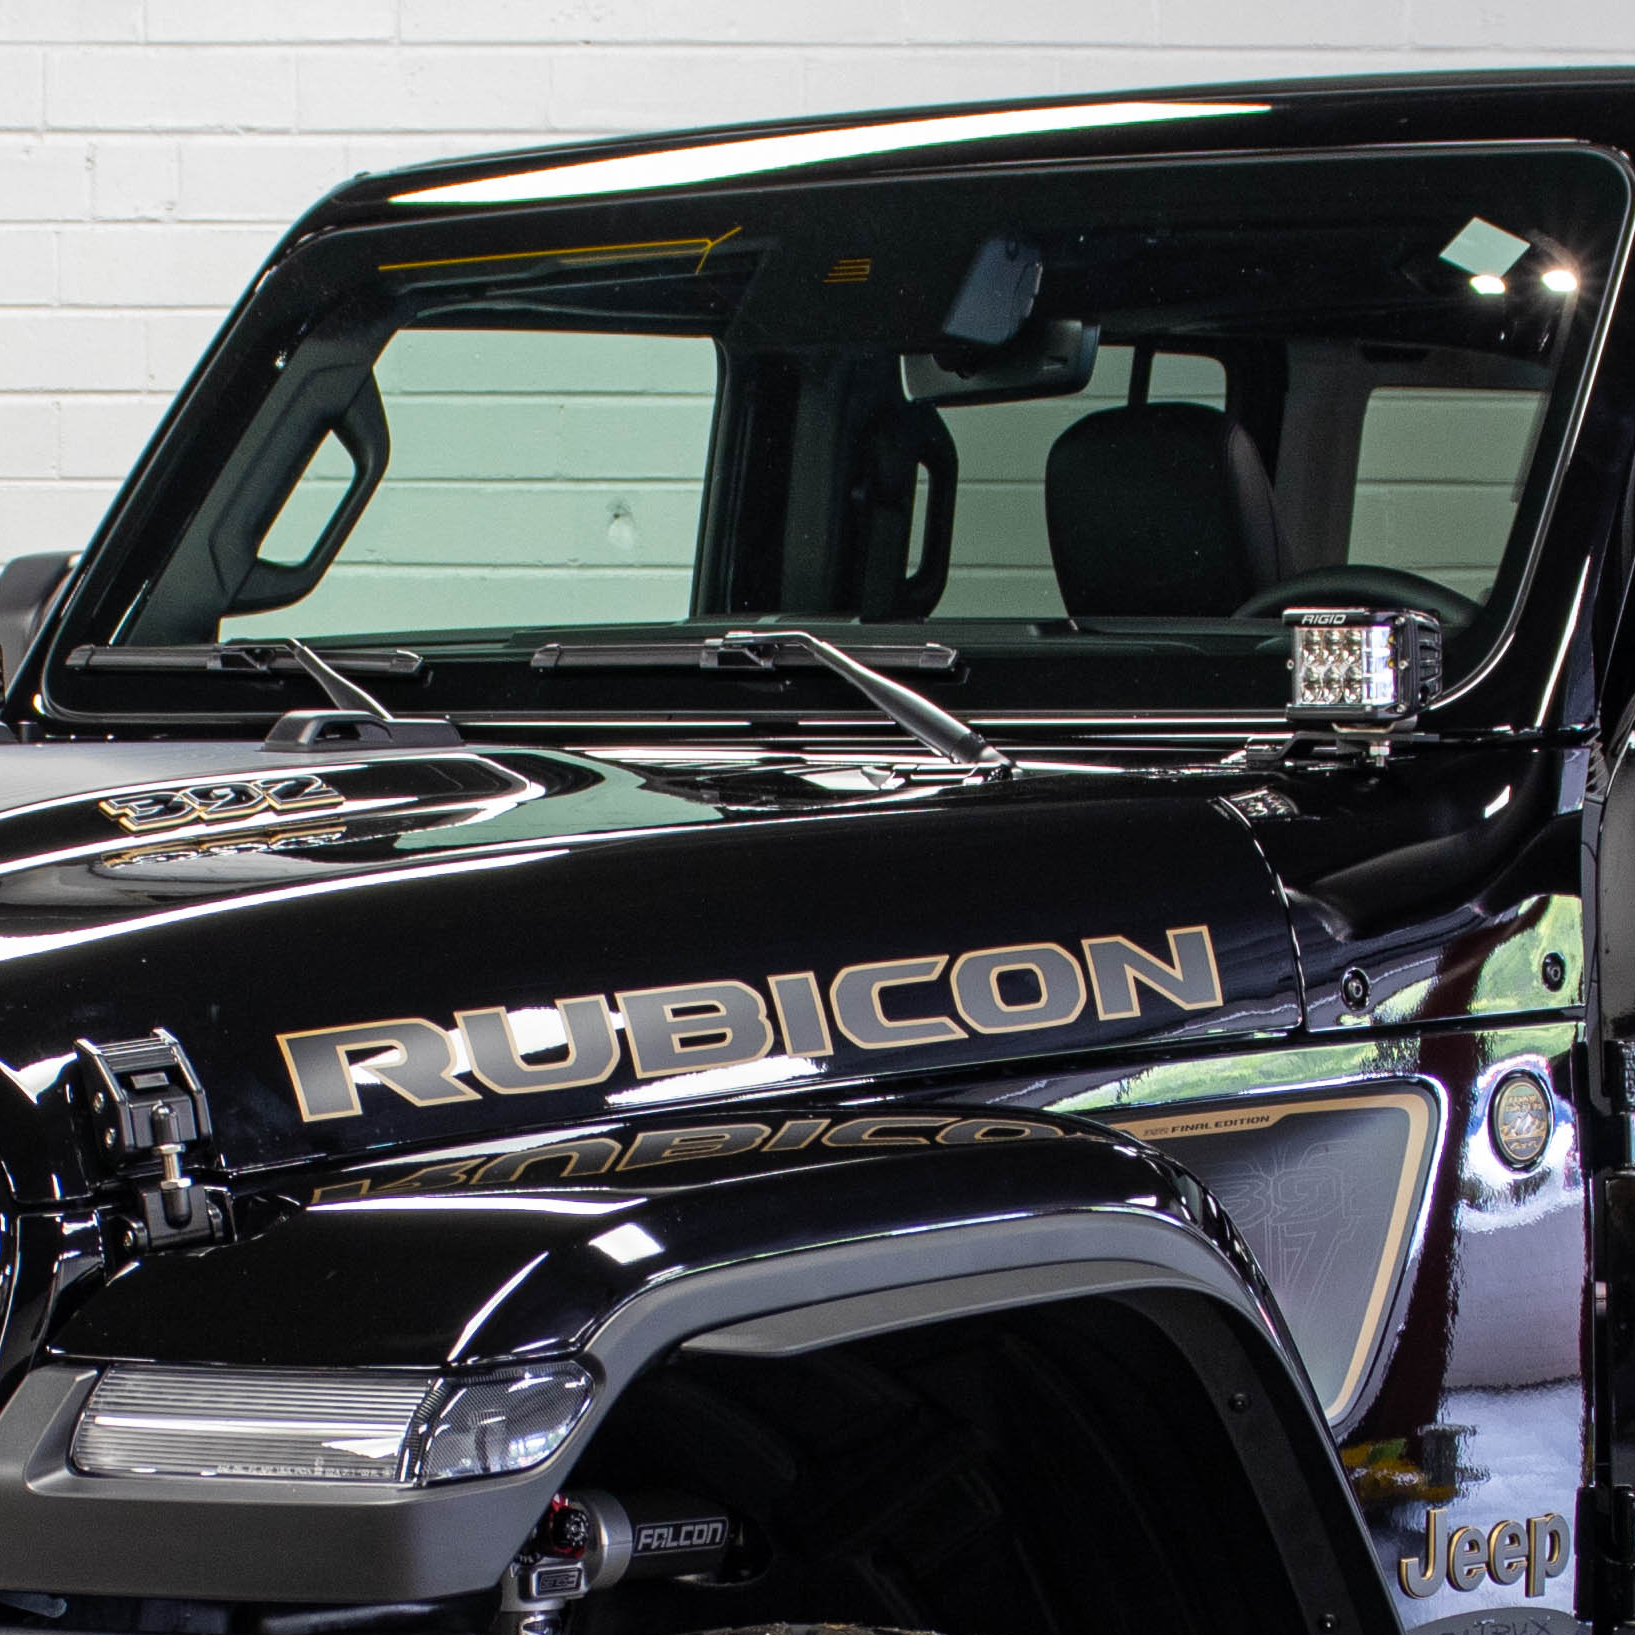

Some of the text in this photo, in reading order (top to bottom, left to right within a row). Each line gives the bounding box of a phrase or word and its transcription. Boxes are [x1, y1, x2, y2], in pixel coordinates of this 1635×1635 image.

[1301, 614, 1347, 625] RIGID
[98, 774, 346, 833] 392
[275, 924, 1225, 1123] RUBICON
[1171, 1121, 1212, 1134] FINAL
[1214, 1115, 1270, 1129] EDITION
[636, 1522, 725, 1551] FALCON
[1398, 1506, 1571, 1600] Jeep
